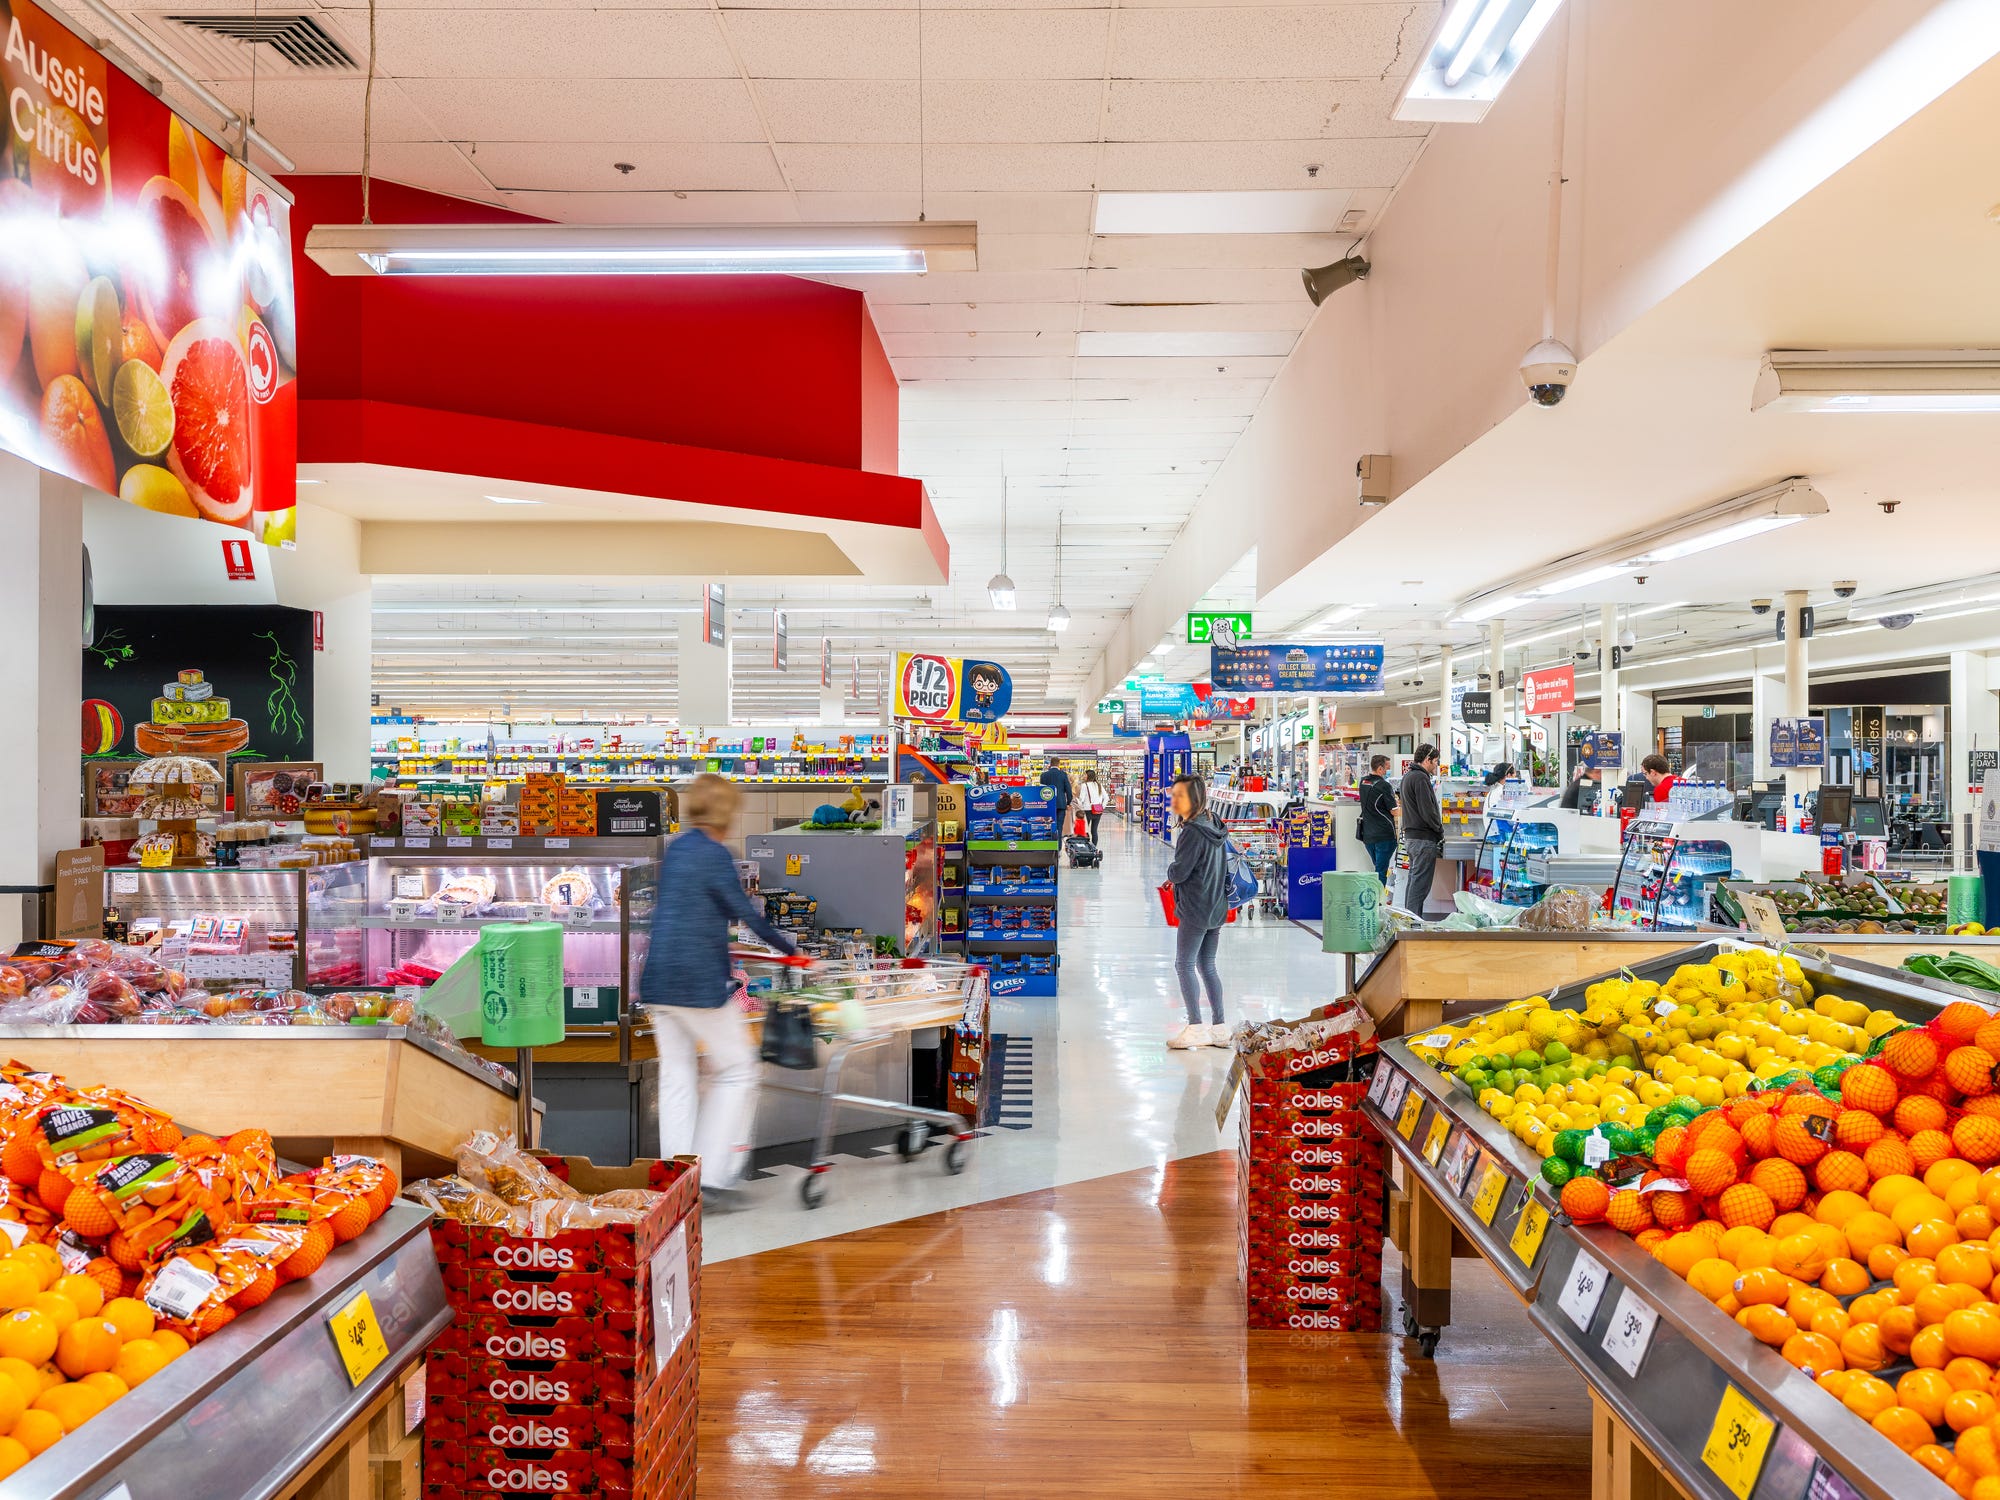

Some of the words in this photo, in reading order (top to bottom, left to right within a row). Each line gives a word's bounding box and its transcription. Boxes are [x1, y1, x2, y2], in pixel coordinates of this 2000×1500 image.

[4, 15, 105, 127] Aussie
[10, 86, 98, 187] Citrus
[1191, 616, 1236, 641] EXT
[1804, 612, 1809, 630] 1
[1614, 651, 1619, 663] 3
[913, 658, 947, 691] 1/2
[910, 690, 948, 708] PRICE
[1255, 735, 1261, 743] 5
[1284, 727, 1291, 737] 2
[1456, 737, 1462, 745] 6
[1475, 736, 1479, 744] 7
[1533, 731, 1544, 741] 10
[1866, 719, 1880, 778] jewellers
[1976, 759, 1997, 767] DAYS
[969, 784, 1008, 798] OREO
[937, 803, 956, 811] OLD
[71, 855, 92, 865] Reusable
[59, 868, 71, 877] Fresh
[72, 866, 91, 875] Produce
[91, 864, 103, 873] Bags
[78, 876, 88, 885] Pack
[1298, 875, 1322, 886] Cadbur
[992, 977, 1026, 990] OREO
[1290, 1048, 1340, 1073] coles
[1291, 1090, 1343, 1110] coles
[51, 1108, 90, 1128] NAVEL
[56, 1115, 94, 1136] ORANGES
[1291, 1118, 1343, 1138] coles
[1291, 1146, 1343, 1165] coles
[108, 1156, 144, 1181] NAVEL
[117, 1161, 151, 1188] ORANGES
[1289, 1174, 1341, 1194] coles
[1288, 1202, 1340, 1221] coles
[1288, 1229, 1340, 1249] coles
[493, 1241, 574, 1268] coles
[1288, 1256, 1340, 1276] coles
[492, 1284, 573, 1312] coles
[1286, 1282, 1338, 1302] coles
[1288, 1310, 1341, 1330] coles
[486, 1331, 566, 1359] coles
[489, 1374, 570, 1402] coles
[489, 1420, 569, 1447] coles
[487, 1463, 568, 1491] coles
